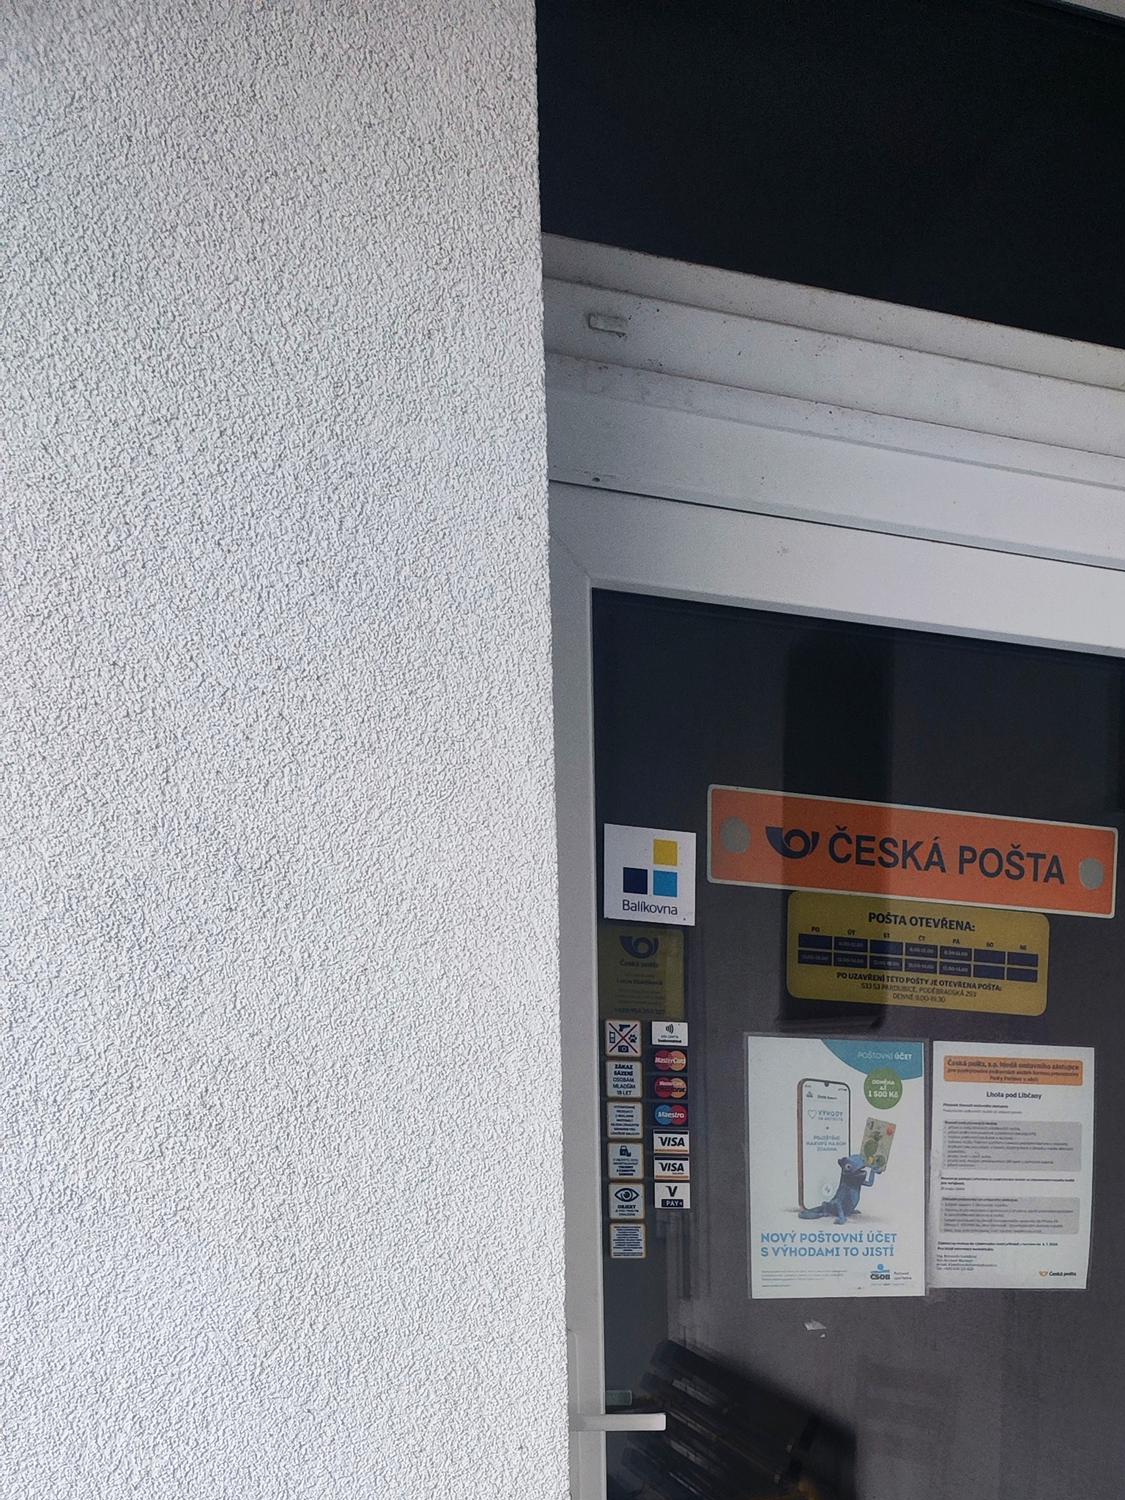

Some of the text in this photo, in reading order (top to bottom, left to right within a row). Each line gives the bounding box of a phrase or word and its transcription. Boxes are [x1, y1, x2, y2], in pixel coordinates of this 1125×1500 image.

[828, 825, 1065, 885] ČESKÁ POŠTA
[622, 898, 678, 916] Balíkovna
[868, 911, 975, 932] POŠTA OTEVŘENA:
[894, 1052, 912, 1060] ÚČET
[658, 1137, 685, 1146] VISA
[659, 1162, 684, 1172] VISA
[665, 1186, 678, 1197] V
[761, 1230, 897, 1243] NOVÝ POŠTOVNÍ ÚČET
[761, 1245, 895, 1257] S VÝHODAMI TO JISTÍ
